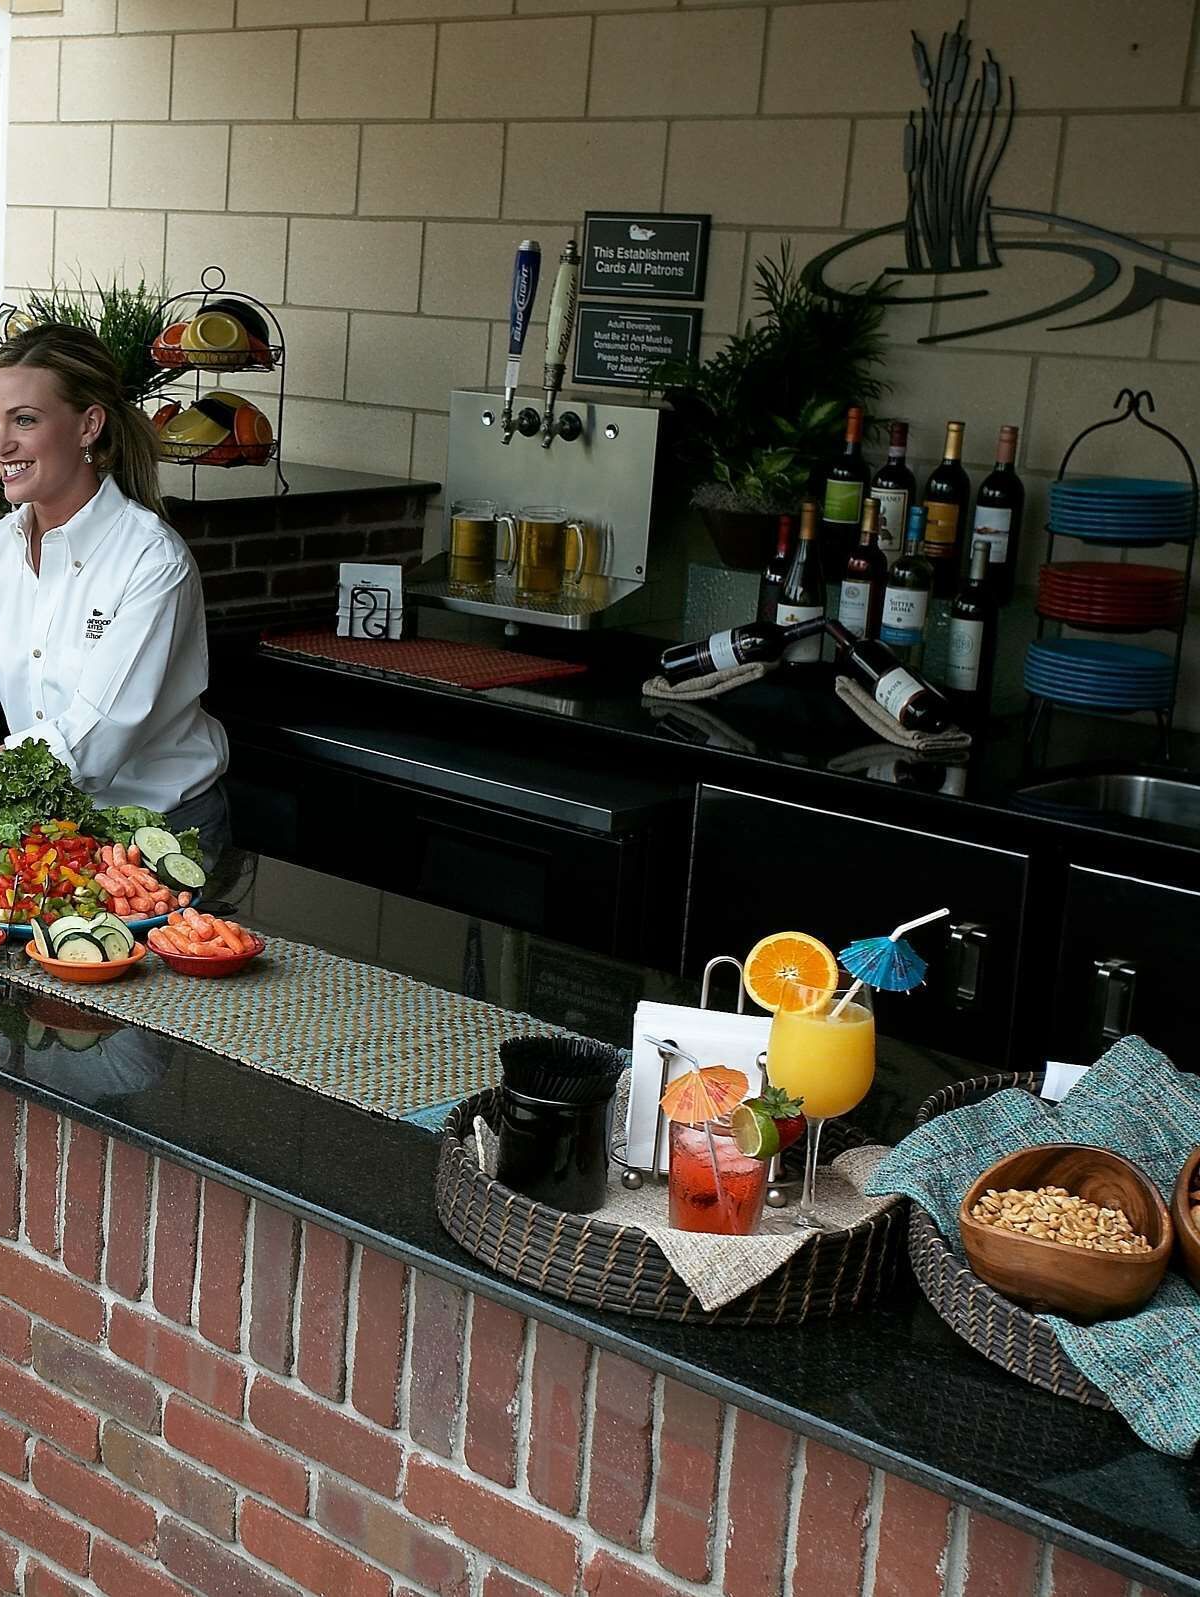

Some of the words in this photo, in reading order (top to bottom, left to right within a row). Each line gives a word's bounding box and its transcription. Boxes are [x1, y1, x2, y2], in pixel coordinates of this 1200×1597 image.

[593, 246, 615, 258] This
[617, 247, 690, 262] Establishment
[596, 260, 626, 274] Cards
[628, 262, 642, 275] All
[644, 264, 684, 277] Patrons
[518, 264, 528, 307] LIGHT
[513, 312, 524, 343] BUD
[608, 320, 625, 330] Adult
[626, 321, 662, 332] Beverages
[594, 332, 610, 340] Must
[611, 332, 621, 341] Be
[622, 333, 630, 342] 21
[631, 334, 645, 343] And
[646, 335, 663, 344] Must
[664, 337, 673, 345] Be
[594, 341, 628, 352] Consumed
[630, 343, 640, 352] On
[642, 344, 672, 354] Premises
[598, 353, 619, 362] Please
[620, 354, 632, 363] See
[606, 363, 618, 371] For
